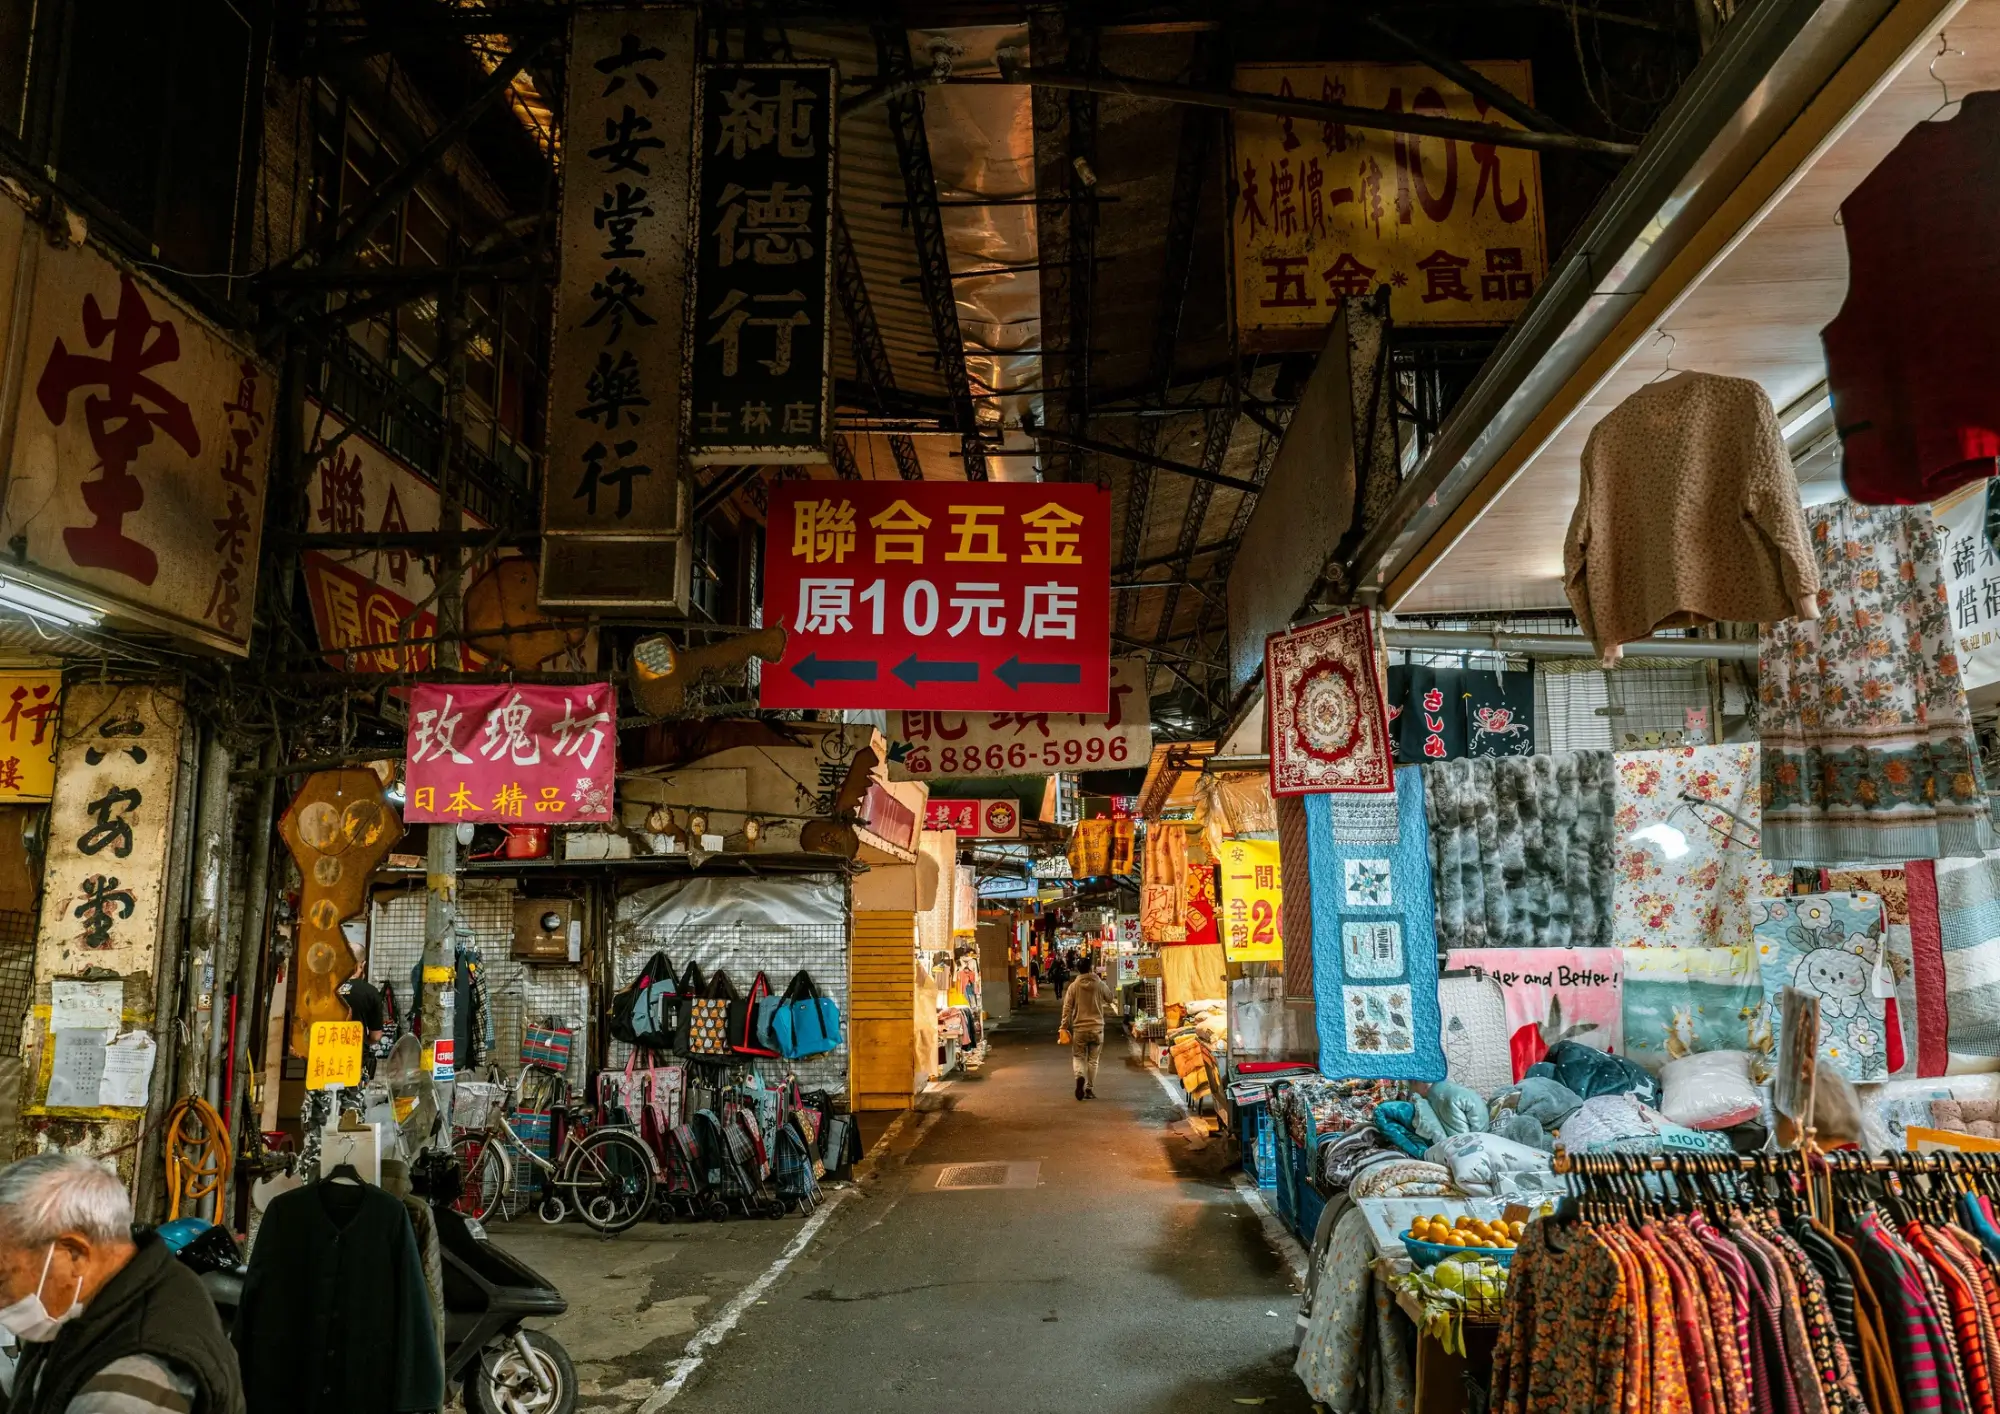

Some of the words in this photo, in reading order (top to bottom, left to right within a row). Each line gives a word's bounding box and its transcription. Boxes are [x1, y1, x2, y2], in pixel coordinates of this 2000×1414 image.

[708, 77, 817, 378] 純德行
[573, 33, 667, 520] 六安堂參藥行
[36, 272, 201, 588] 堂
[697, 403, 815, 436] 士林店
[201, 359, 266, 630] 真正老店
[791, 498, 1086, 566] 聯合五金
[793, 577, 1080, 641] 原10元店
[411, 691, 611, 771] 玫瑰坊
[939, 736, 1128, 773] 8866-5996
[1423, 687, 1448, 758] さしみ
[73, 710, 148, 949] 六安堂
[413, 781, 567, 818] 日本精品
[1523, 971, 1553, 988] and
[1668, 1134, 1706, 1148] $100
